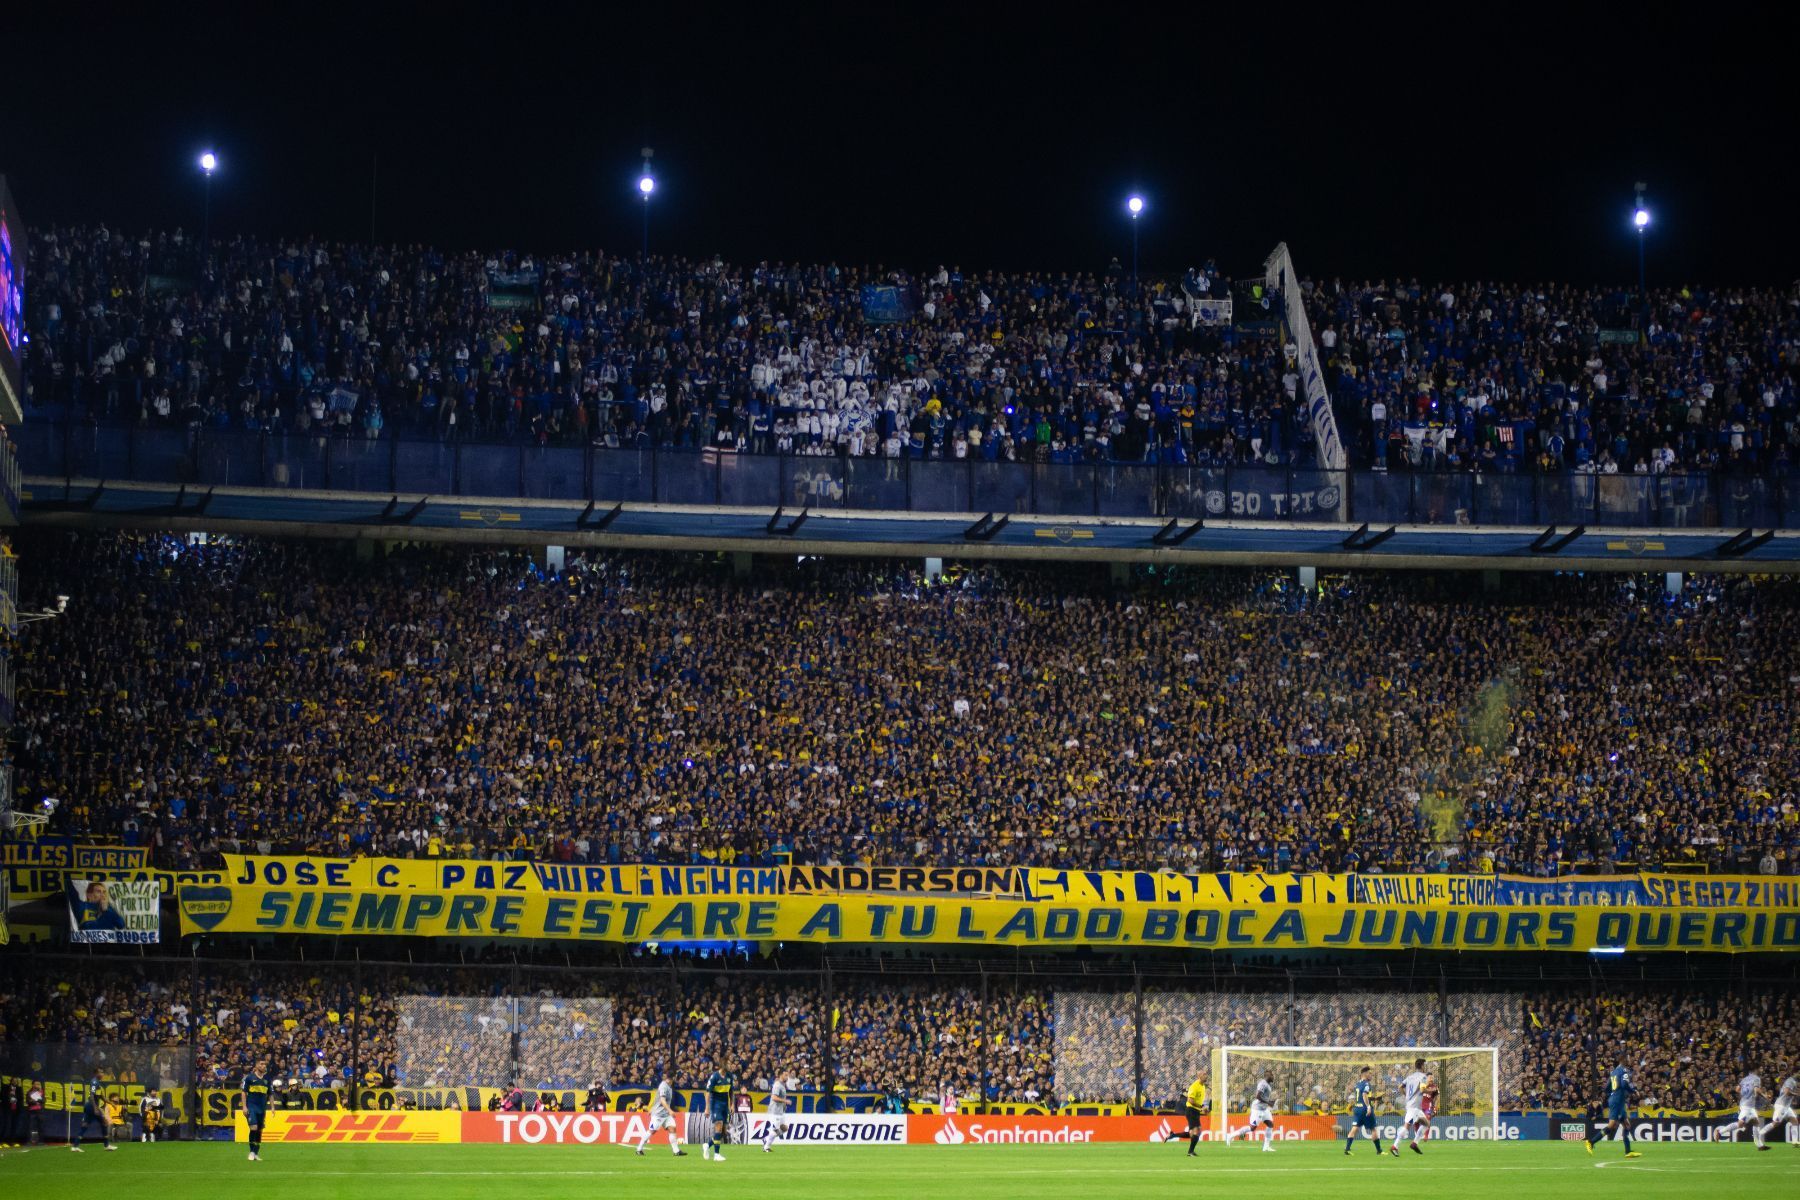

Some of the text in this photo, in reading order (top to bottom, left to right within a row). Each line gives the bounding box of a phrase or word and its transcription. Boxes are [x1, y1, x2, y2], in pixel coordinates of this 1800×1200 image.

[237, 860, 354, 887] JOSE
[442, 865, 527, 890] PAZ
[787, 867, 1014, 893] ANDERSON
[1027, 867, 1348, 903] SAN MARTIN
[108, 881, 159, 901] GRACIAS
[121, 896, 151, 911] POR TU
[1363, 876, 1426, 904] CAPILLA
[1428, 884, 1446, 899] DEL
[1650, 877, 1799, 907] SPEGAZZINI
[125, 914, 159, 930] LEALTAD
[255, 891, 522, 934] SIEMPRE
[543, 898, 778, 938] ESTARE
[799, 903, 842, 939] A
[866, 904, 938, 939] TU
[1322, 909, 1578, 947] JUNIORS
[282, 1114, 415, 1141] DHL
[495, 1113, 650, 1144] TOYOTA
[751, 1120, 904, 1141] BIDGESTONE
[969, 1123, 1094, 1144] Santander
